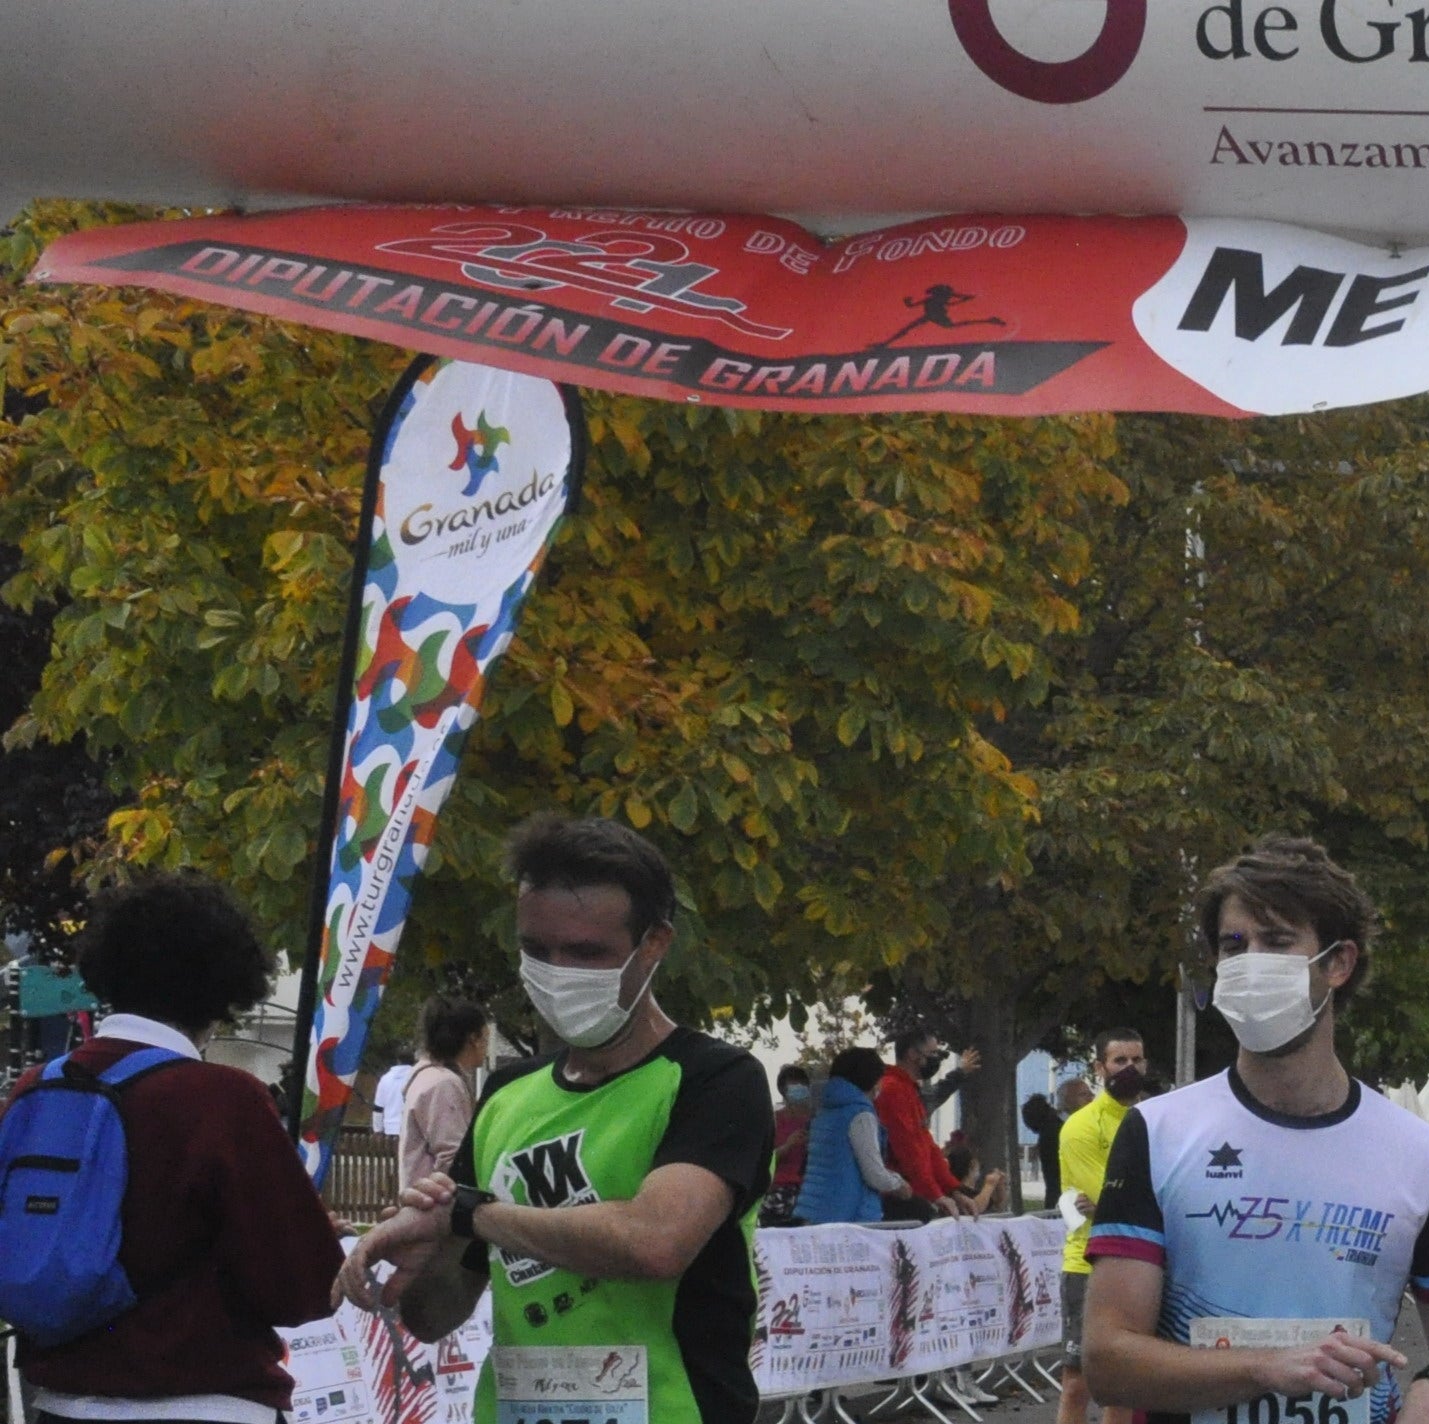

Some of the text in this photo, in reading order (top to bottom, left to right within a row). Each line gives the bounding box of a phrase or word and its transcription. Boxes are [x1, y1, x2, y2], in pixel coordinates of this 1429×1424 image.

[1196, 0, 1299, 62] de
[743, 230, 818, 275] DE
[834, 225, 1026, 274] FONDO
[180, 245, 996, 396] DIPUTACIÓN DE GRANADA
[399, 469, 556, 546] Granada
